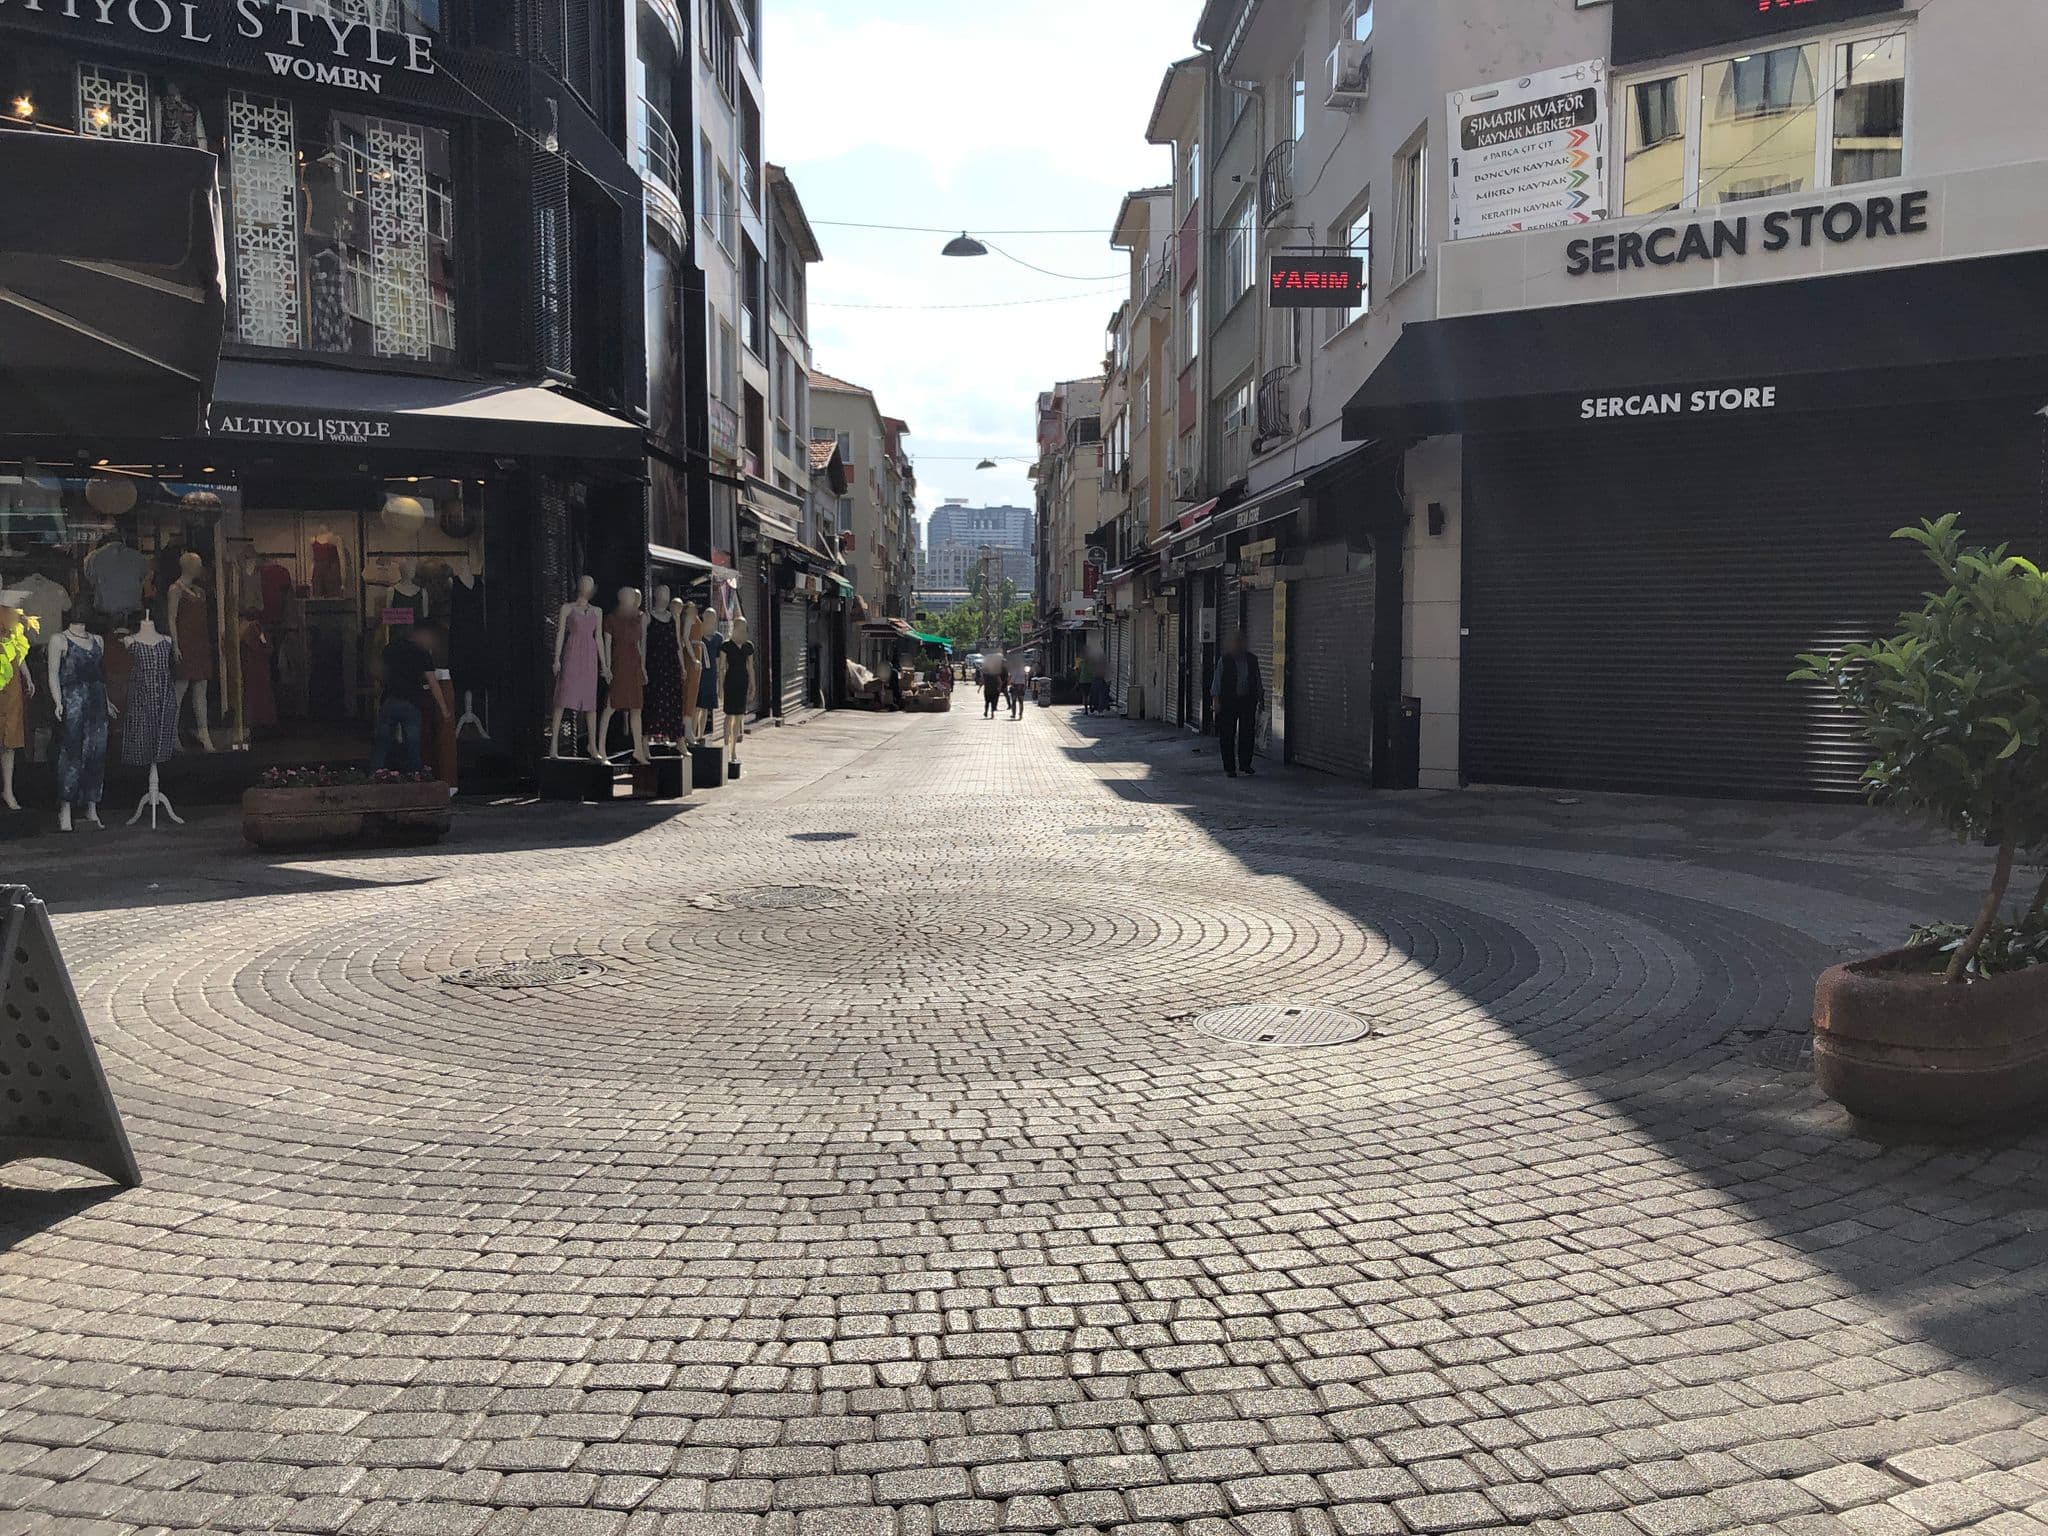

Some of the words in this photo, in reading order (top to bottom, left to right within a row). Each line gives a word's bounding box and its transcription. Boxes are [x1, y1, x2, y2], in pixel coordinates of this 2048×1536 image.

[237, 0, 435, 74] STYLE
[264, 52, 382, 94] WOMEN
[1470, 107, 1527, 137] ŞIMARIK
[1529, 94, 1585, 120] KUAFÖR
[1478, 126, 1523, 147] KAYNAK
[1525, 112, 1576, 137] MERKEZİ
[1474, 167, 1521, 183] BONCUK
[1523, 156, 1570, 172] KAYNAK
[1518, 176, 1568, 189] KAYNAK
[1523, 199, 1563, 212] KAYNAK
[1566, 216, 1747, 276] SERCAN
[1764, 190, 1928, 251] STORE
[1272, 271, 1348, 289] YARIM
[1580, 393, 1681, 419] SERCAN
[1690, 386, 1776, 412] STORE
[220, 416, 318, 438] ALTIYOL
[325, 419, 391, 438] STYLE
[330, 434, 368, 443] WOMEN
